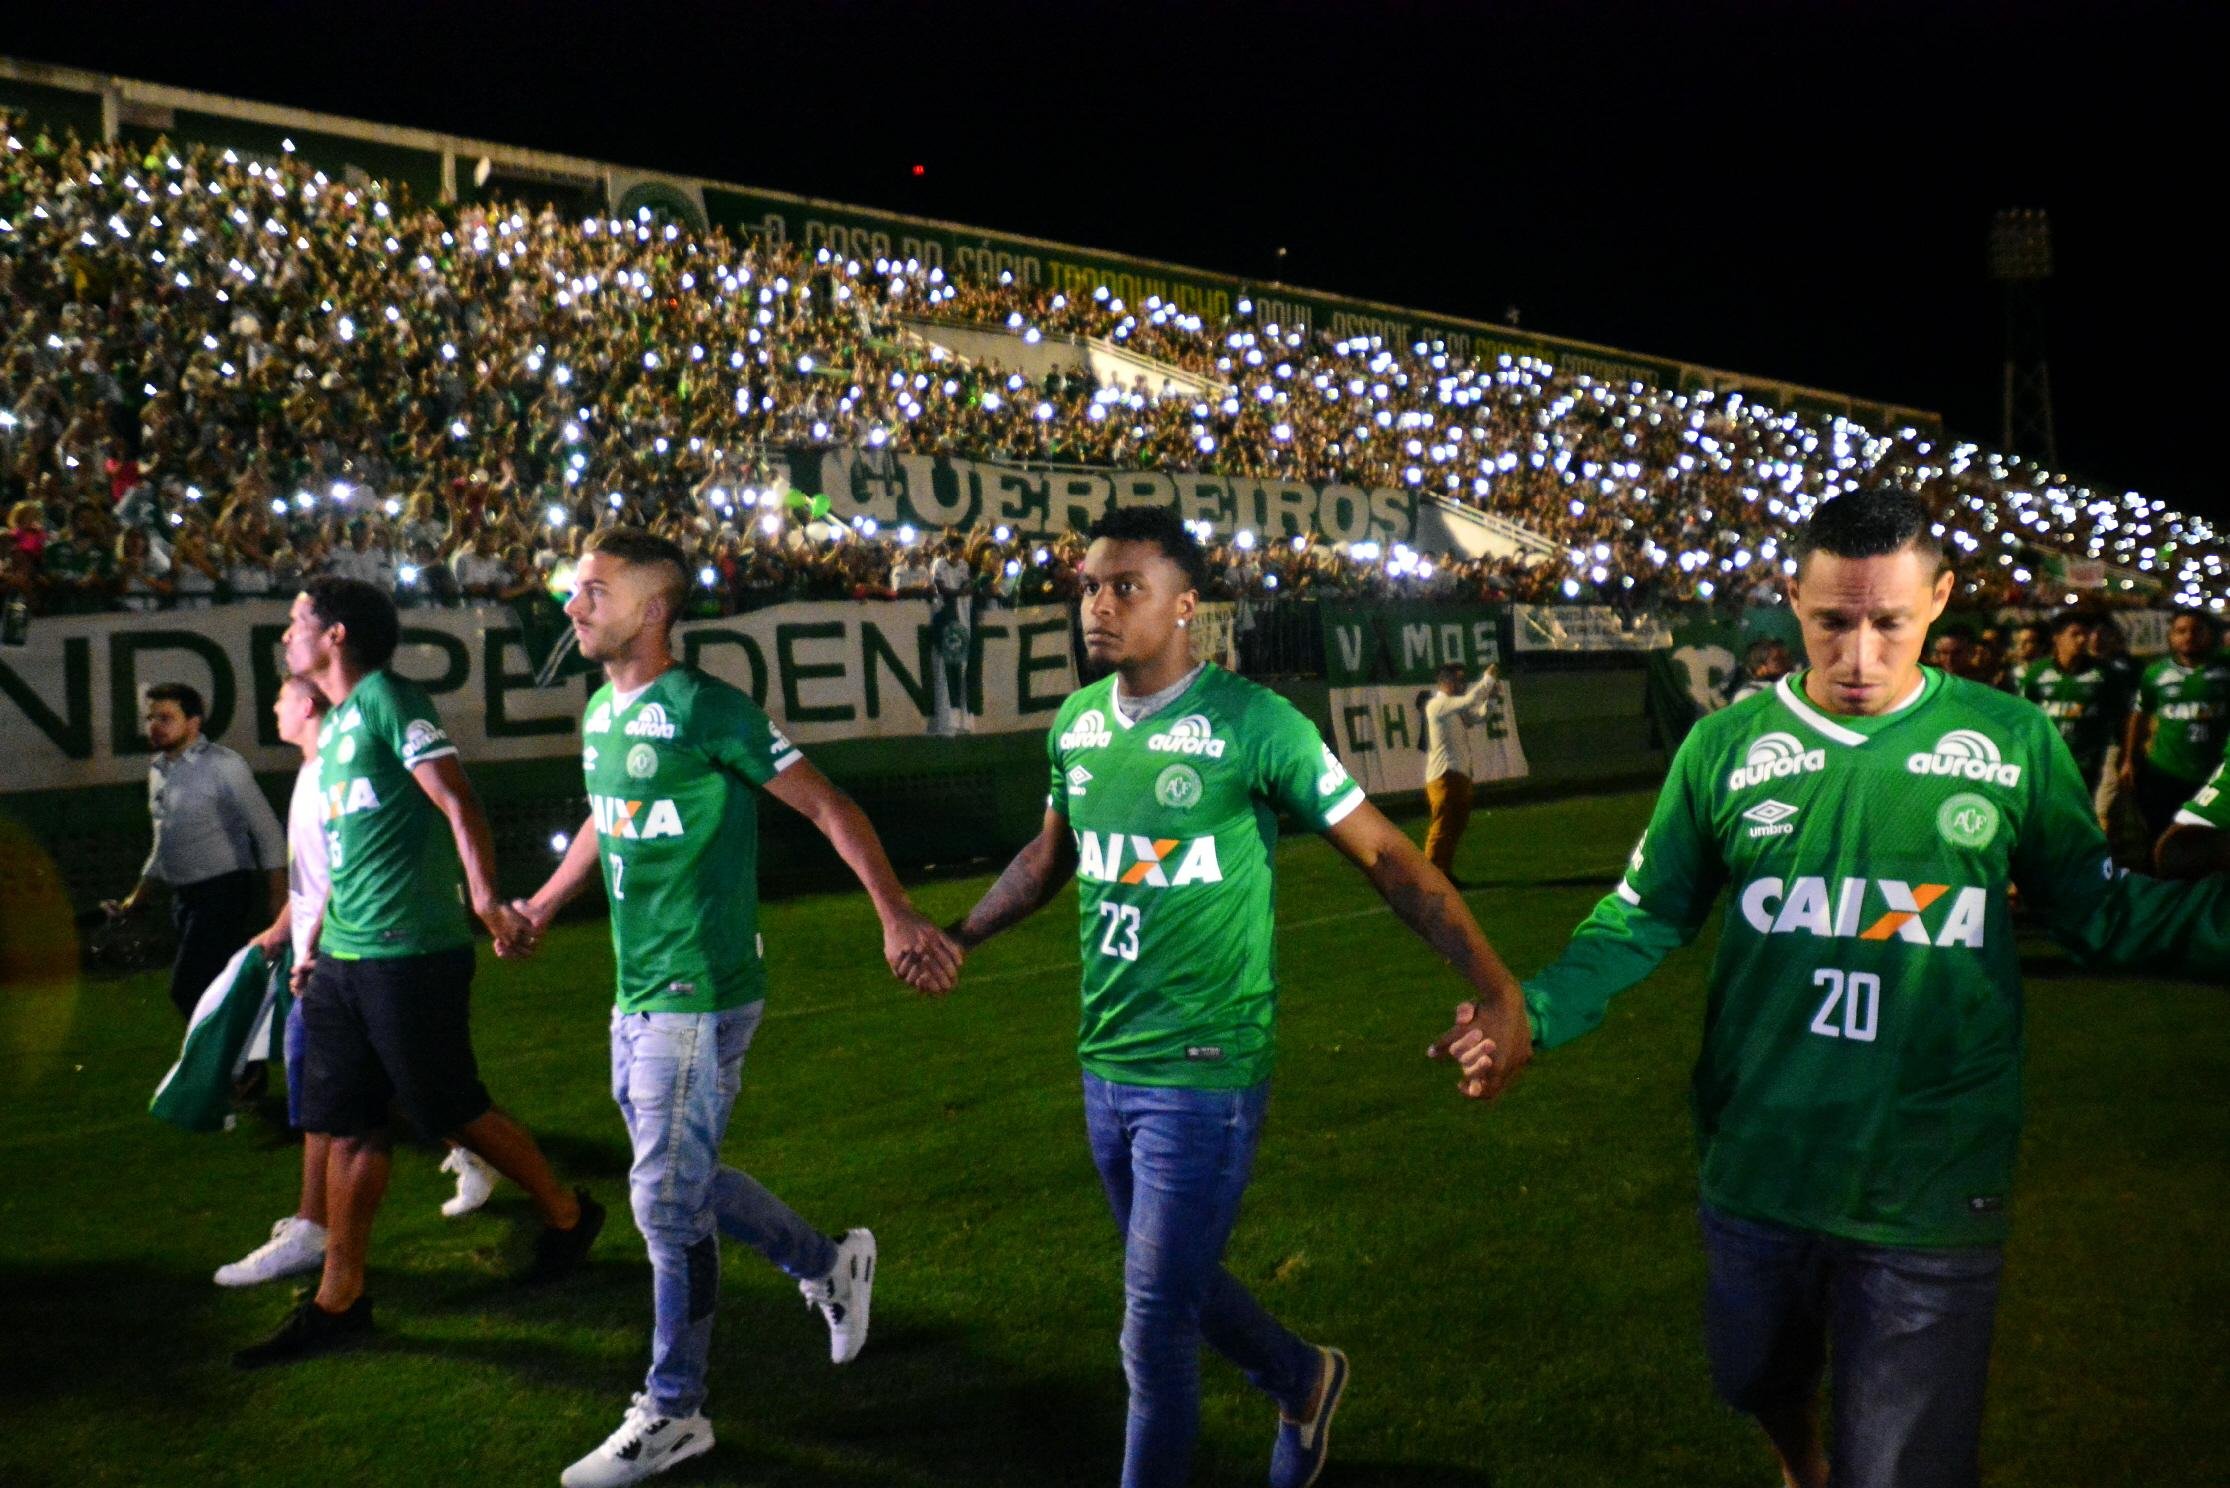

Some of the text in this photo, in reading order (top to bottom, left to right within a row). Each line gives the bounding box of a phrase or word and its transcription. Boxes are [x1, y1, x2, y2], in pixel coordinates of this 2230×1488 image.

[1336, 620, 1500, 671] VMOS
[1148, 733, 1226, 758] aurora
[1344, 692, 1508, 754] CHE
[1729, 749, 1825, 791] aurora
[1908, 753, 2021, 788] aurora
[589, 794, 684, 840] AIXA
[1749, 822, 1794, 838] umbro
[1073, 830, 1223, 887] AIXA
[1100, 901, 1141, 962] 23
[1741, 876, 1987, 949] CAIXA
[1810, 968, 1881, 1042] 20
